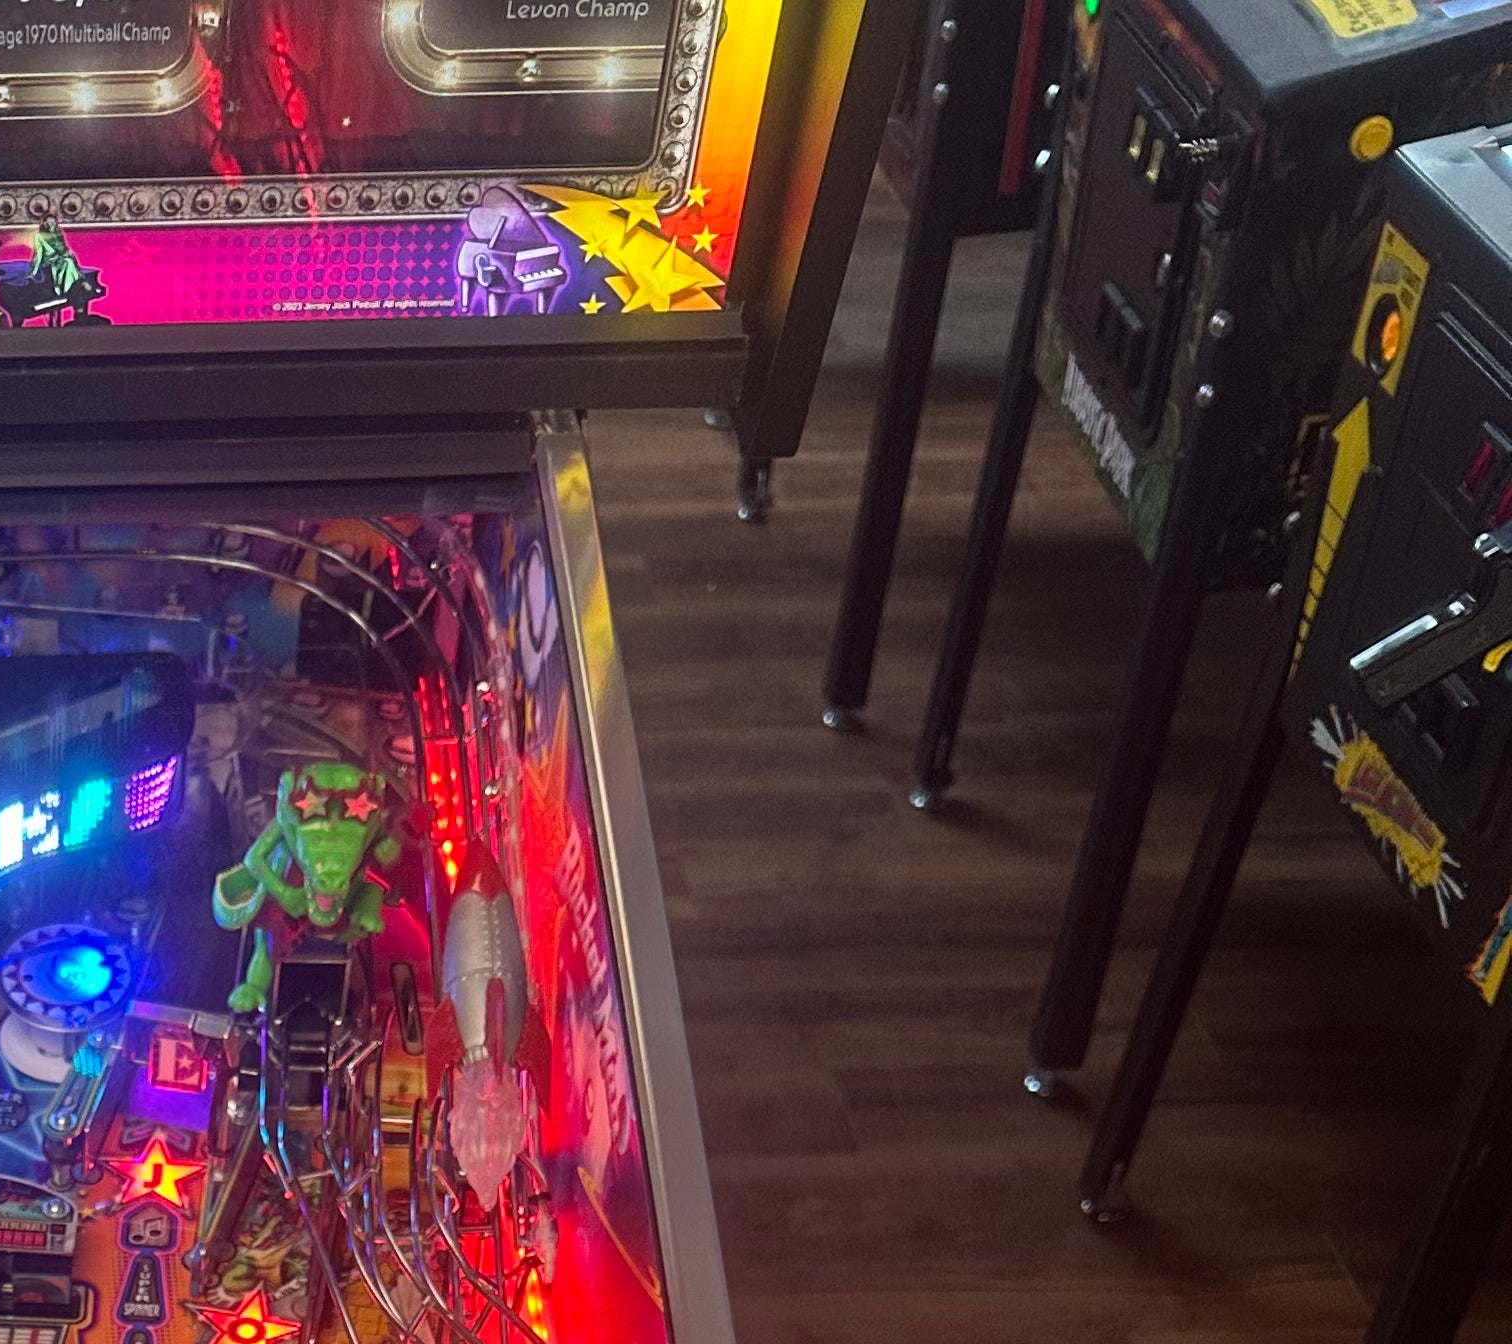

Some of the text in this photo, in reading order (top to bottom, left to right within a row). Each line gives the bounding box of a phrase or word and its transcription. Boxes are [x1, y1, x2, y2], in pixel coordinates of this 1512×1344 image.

[506, 0, 649, 21] Levon Champ
[25, 24, 58, 44] 1970
[59, 23, 121, 43] Multiball
[122, 22, 172, 44] Champ
[227, 1317, 266, 1344] O
